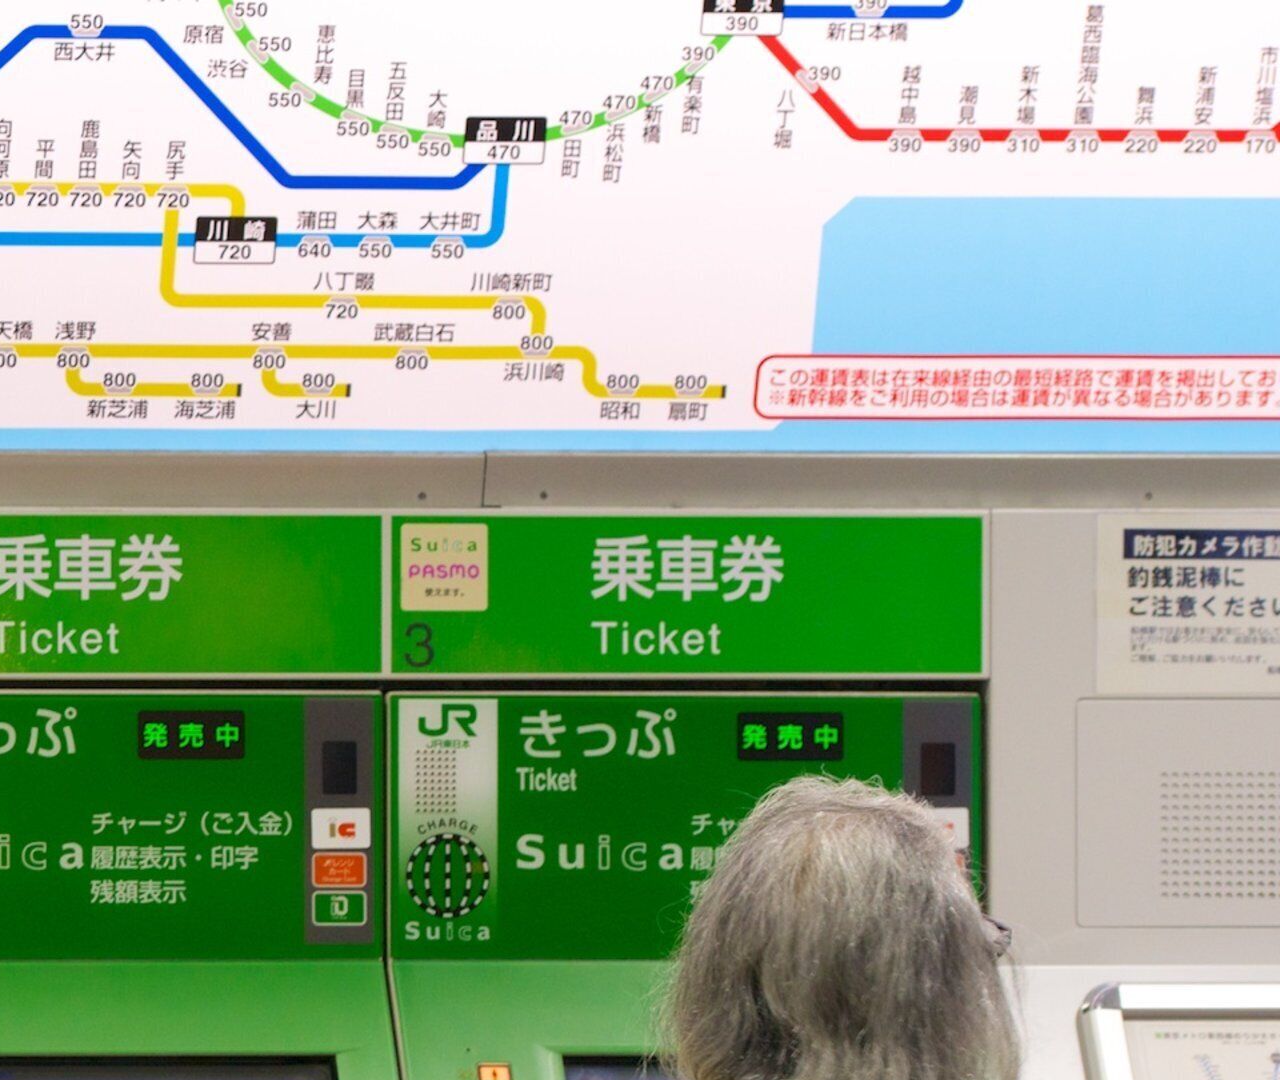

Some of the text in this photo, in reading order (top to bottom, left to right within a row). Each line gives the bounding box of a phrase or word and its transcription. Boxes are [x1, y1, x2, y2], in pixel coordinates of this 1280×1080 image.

[827, 23, 908, 42] 新日本橋
[898, 66, 921, 124] 越中島
[1018, 66, 1040, 124] 新木場
[478, 120, 535, 142] 品川
[488, 146, 520, 159] 470
[889, 138, 921, 153] 390
[207, 220, 266, 241] 川崎
[298, 211, 336, 229] 蒲田
[421, 213, 480, 230] 大井町
[472, 274, 551, 291] 川崎新町
[56, 322, 95, 340] 浅野
[505, 364, 563, 381] 浜川崎
[601, 402, 639, 419] 昭和
[411, 538, 478, 552] Suica
[408, 564, 480, 580] PASMO
[591, 535, 784, 602] 乗車券
[1128, 566, 1245, 588] 釣銭泥棒に
[403, 623, 435, 667] 3
[591, 622, 721, 656] Ticket
[418, 704, 478, 738] JR
[144, 723, 240, 749] 発売中
[519, 709, 677, 759] きっぷ
[743, 725, 839, 750] 発売中
[516, 767, 577, 792] Ticket
[91, 812, 293, 837] チャージ（ご入金）
[417, 818, 480, 836] CHARGE
[91, 846, 259, 870] 履歴表示・印字
[516, 835, 684, 871] Suica
[91, 880, 187, 904] 残額表示
[405, 922, 491, 941] Suica
